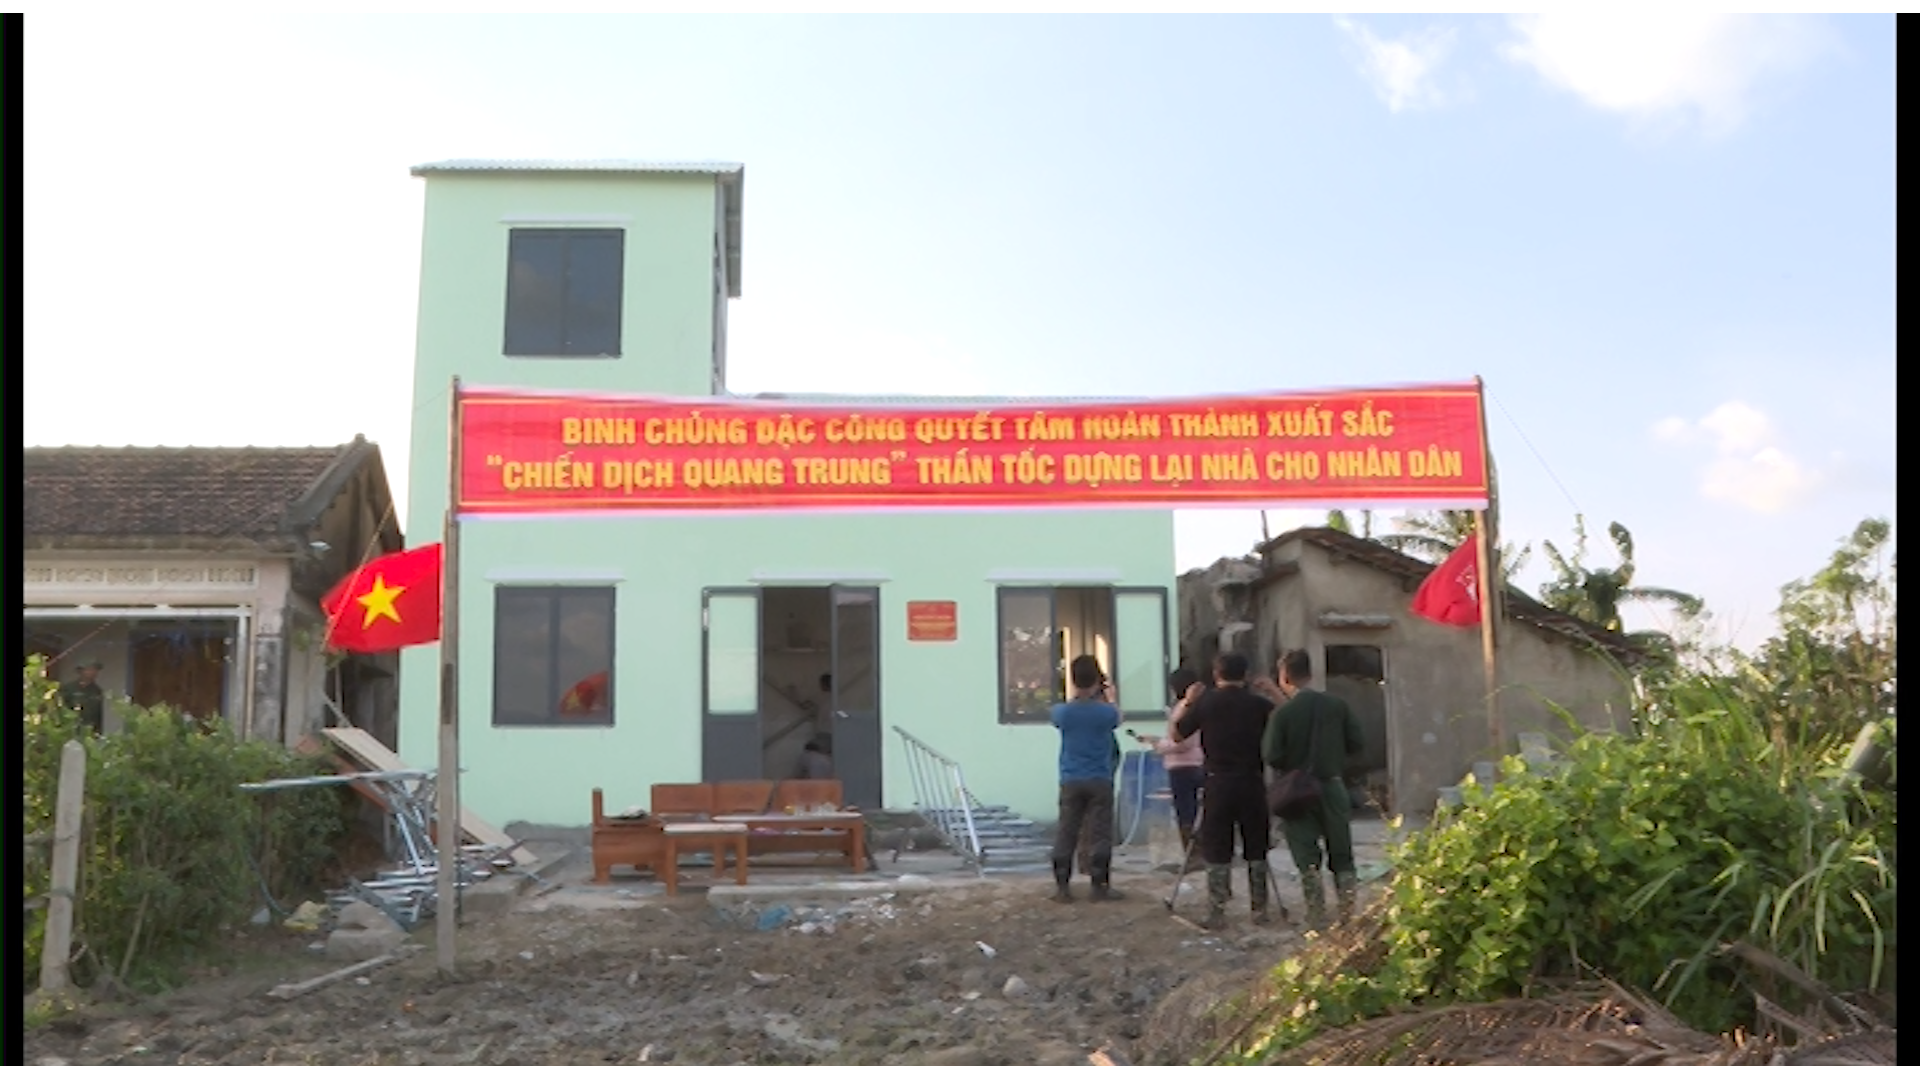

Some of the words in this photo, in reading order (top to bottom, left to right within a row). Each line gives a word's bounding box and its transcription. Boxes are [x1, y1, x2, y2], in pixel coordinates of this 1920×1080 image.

[562, 417, 635, 445] BINH
[755, 414, 815, 450] ĐẶC
[825, 414, 905, 442] CÔNG
[915, 410, 1005, 442] QUYẾT
[1014, 411, 1074, 440] TÂM
[1168, 407, 1259, 437] THÀNH
[1267, 403, 1333, 437] XUẤT
[1342, 400, 1394, 437] SẮC
[603, 461, 673, 495] DỊCH
[683, 458, 784, 490] QUANG
[1000, 448, 1056, 483] TỐC
[1064, 451, 1142, 487] DỰNG
[1151, 455, 1192, 487] LẠI
[1201, 448, 1259, 481] NHÀ
[1266, 451, 1320, 481] CHO
[1328, 446, 1401, 477] NHÂN
[1408, 444, 1461, 477] DÂN
